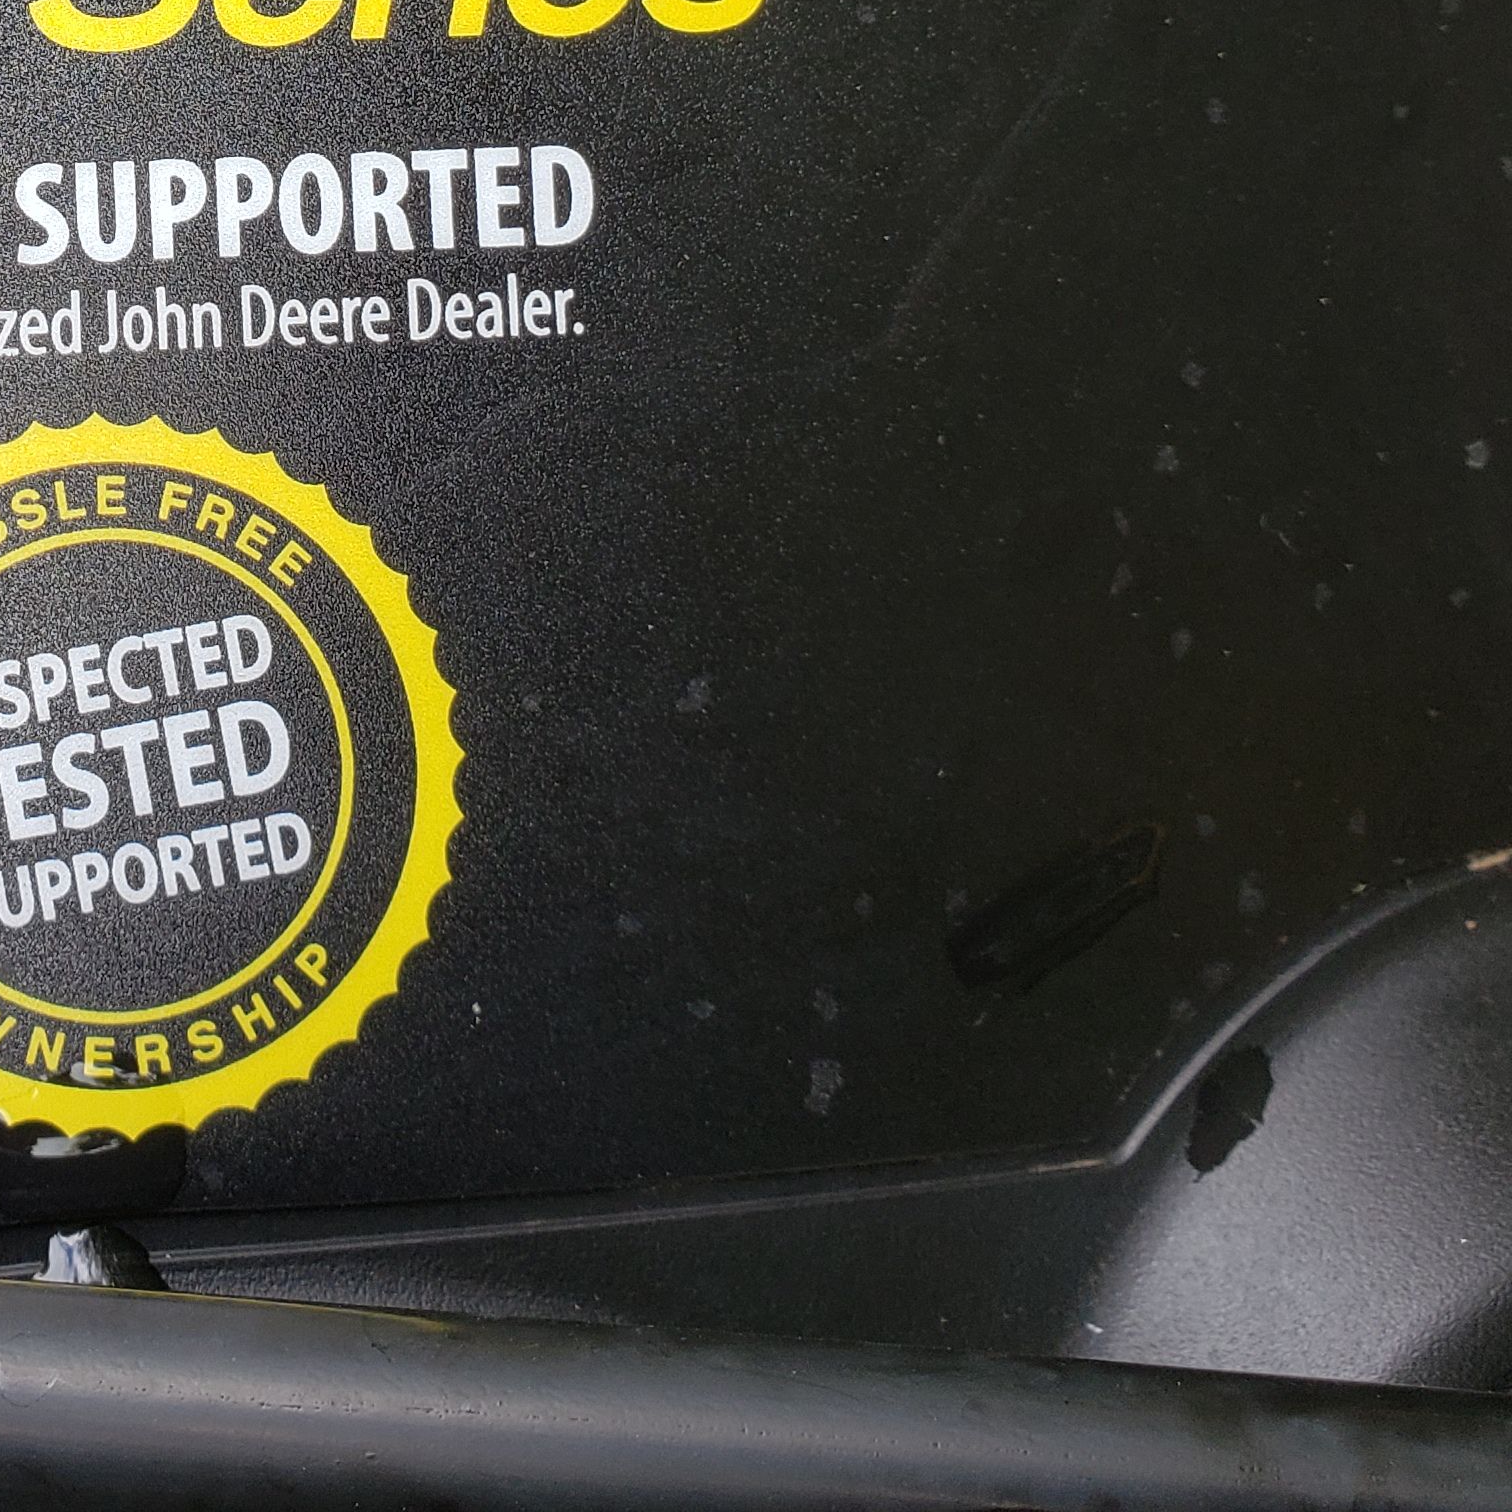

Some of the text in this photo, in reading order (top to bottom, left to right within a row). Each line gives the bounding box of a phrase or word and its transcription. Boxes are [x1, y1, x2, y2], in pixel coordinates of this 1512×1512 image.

[15, 144, 595, 265] SUPPORTED
[96, 283, 223, 355] John
[242, 282, 391, 346] Deere
[407, 272, 585, 340] Dealer.
[157, 480, 314, 589] FREE
